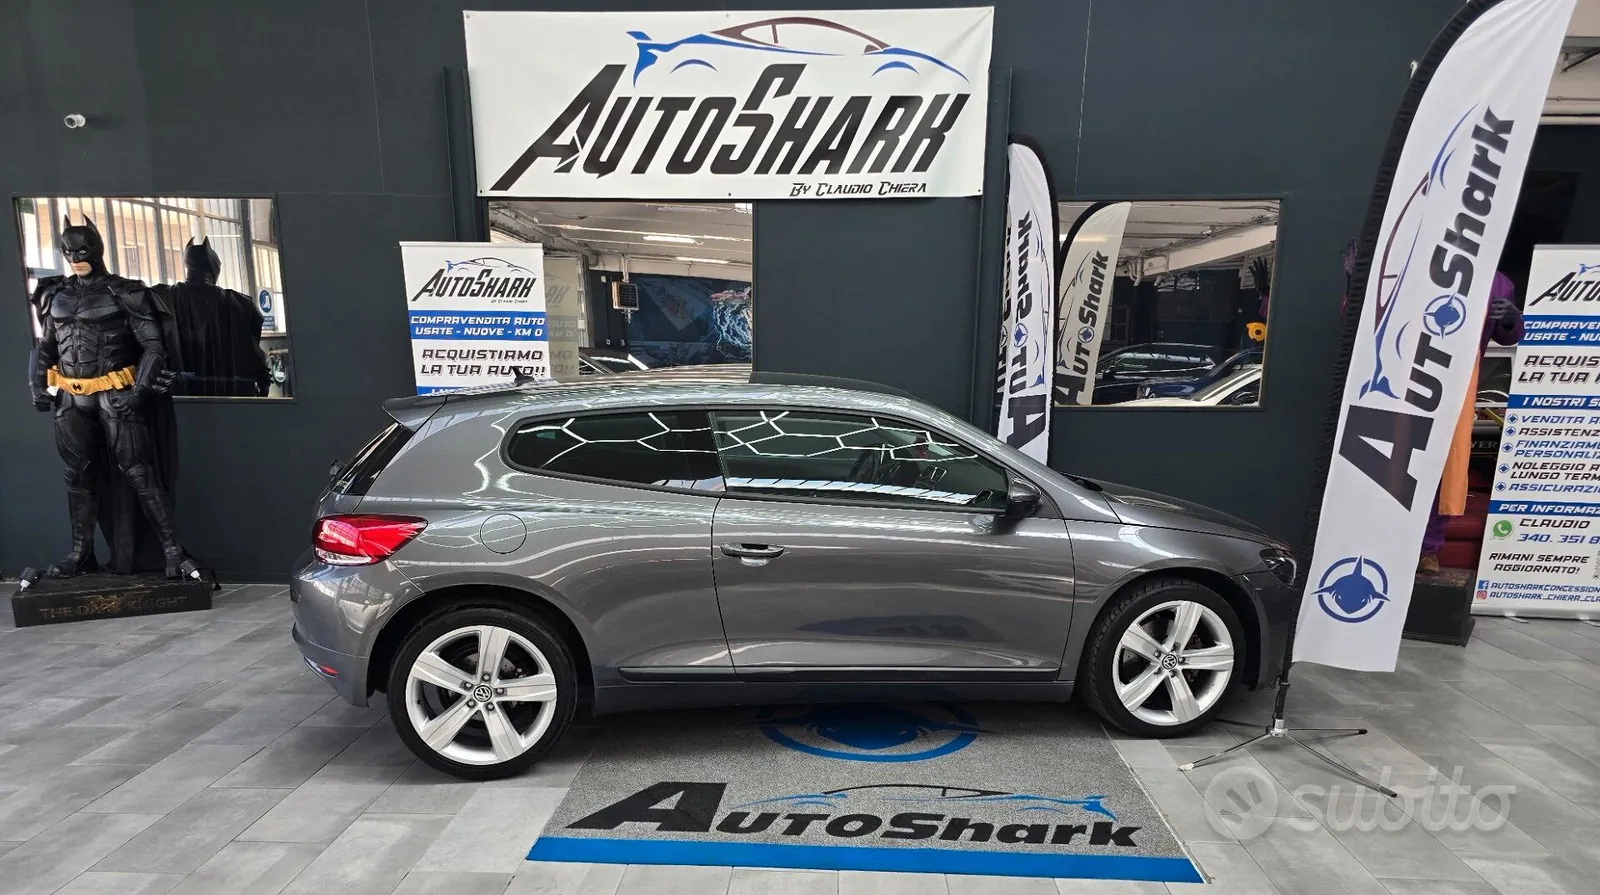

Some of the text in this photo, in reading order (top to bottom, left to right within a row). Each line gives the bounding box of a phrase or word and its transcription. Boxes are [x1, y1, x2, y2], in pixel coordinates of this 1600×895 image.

[490, 64, 971, 192] AUTOSHARK
[411, 316, 545, 326] COMPRAVENDITA AUTO
[415, 327, 453, 335] USATE
[464, 328, 505, 336] NUOVE
[515, 328, 531, 337] KM
[1524, 333, 1568, 341] USATE
[422, 349, 544, 361] ACQUISTIAMO
[1524, 355, 1600, 367] ACQUIS
[421, 365, 442, 375] LA
[448, 365, 482, 376] TUA
[1518, 371, 1544, 382] LA
[1550, 372, 1590, 383] TUA
[1522, 397, 1529, 406] I
[1531, 397, 1587, 407] NOSTRI
[1522, 416, 1585, 424] VENDITA
[1511, 462, 1586, 471] NOLEGGIO
[1510, 471, 1561, 480] LUNGO
[1499, 504, 1528, 512] PER
[1519, 519, 1591, 529] CLAUDIO
[1557, 535, 1586, 544] 351
[1489, 553, 1590, 564] RIMANI SEMPRE
[1493, 564, 1580, 574] AGGIORNATO!
